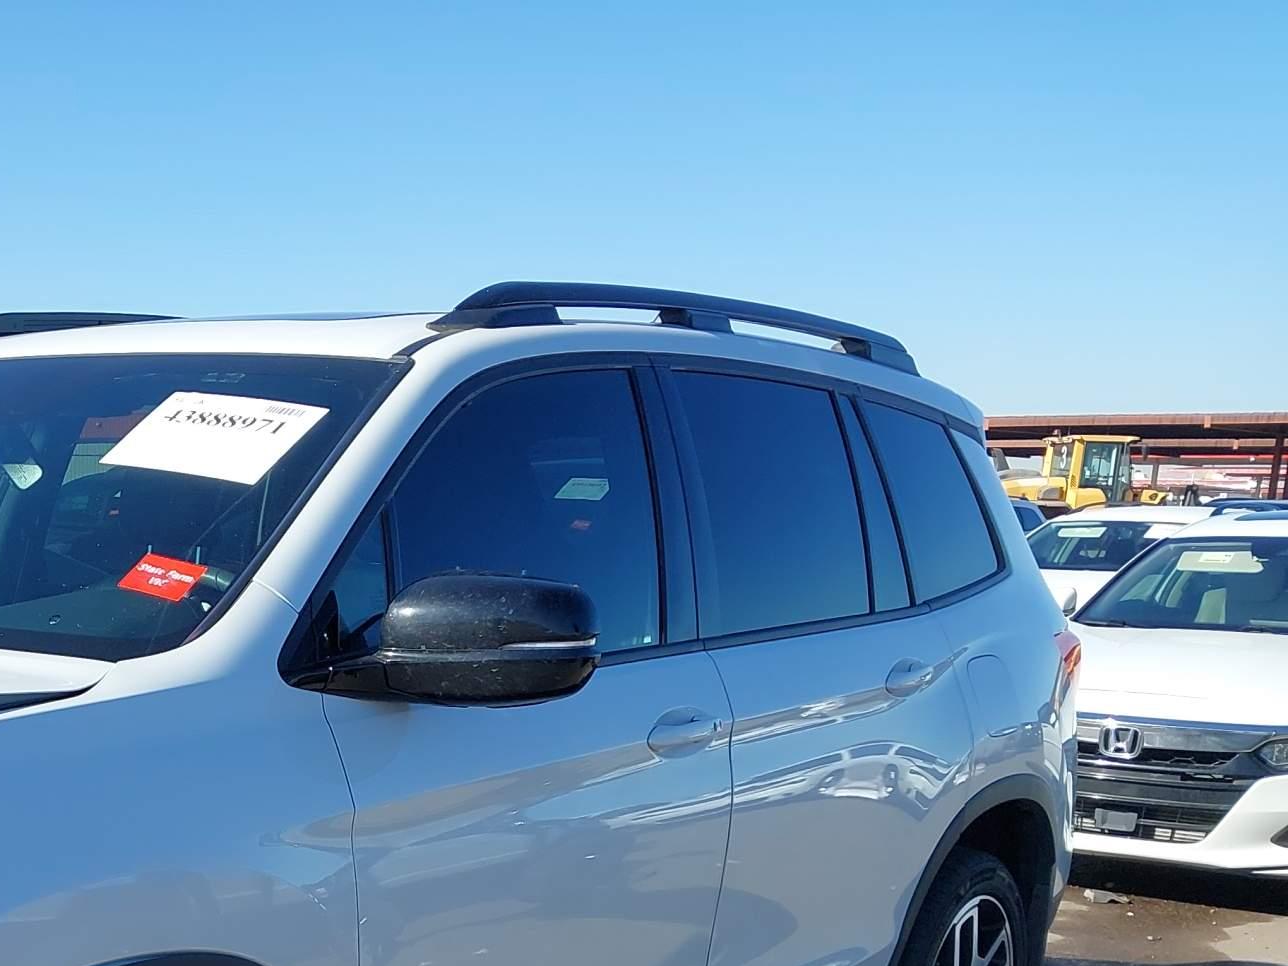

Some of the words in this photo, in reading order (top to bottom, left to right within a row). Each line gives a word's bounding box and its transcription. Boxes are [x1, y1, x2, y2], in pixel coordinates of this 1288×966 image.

[164, 409, 287, 434] 43888971
[1059, 445, 1068, 469] 3
[137, 563, 166, 576] State
[166, 569, 196, 584] Farm
